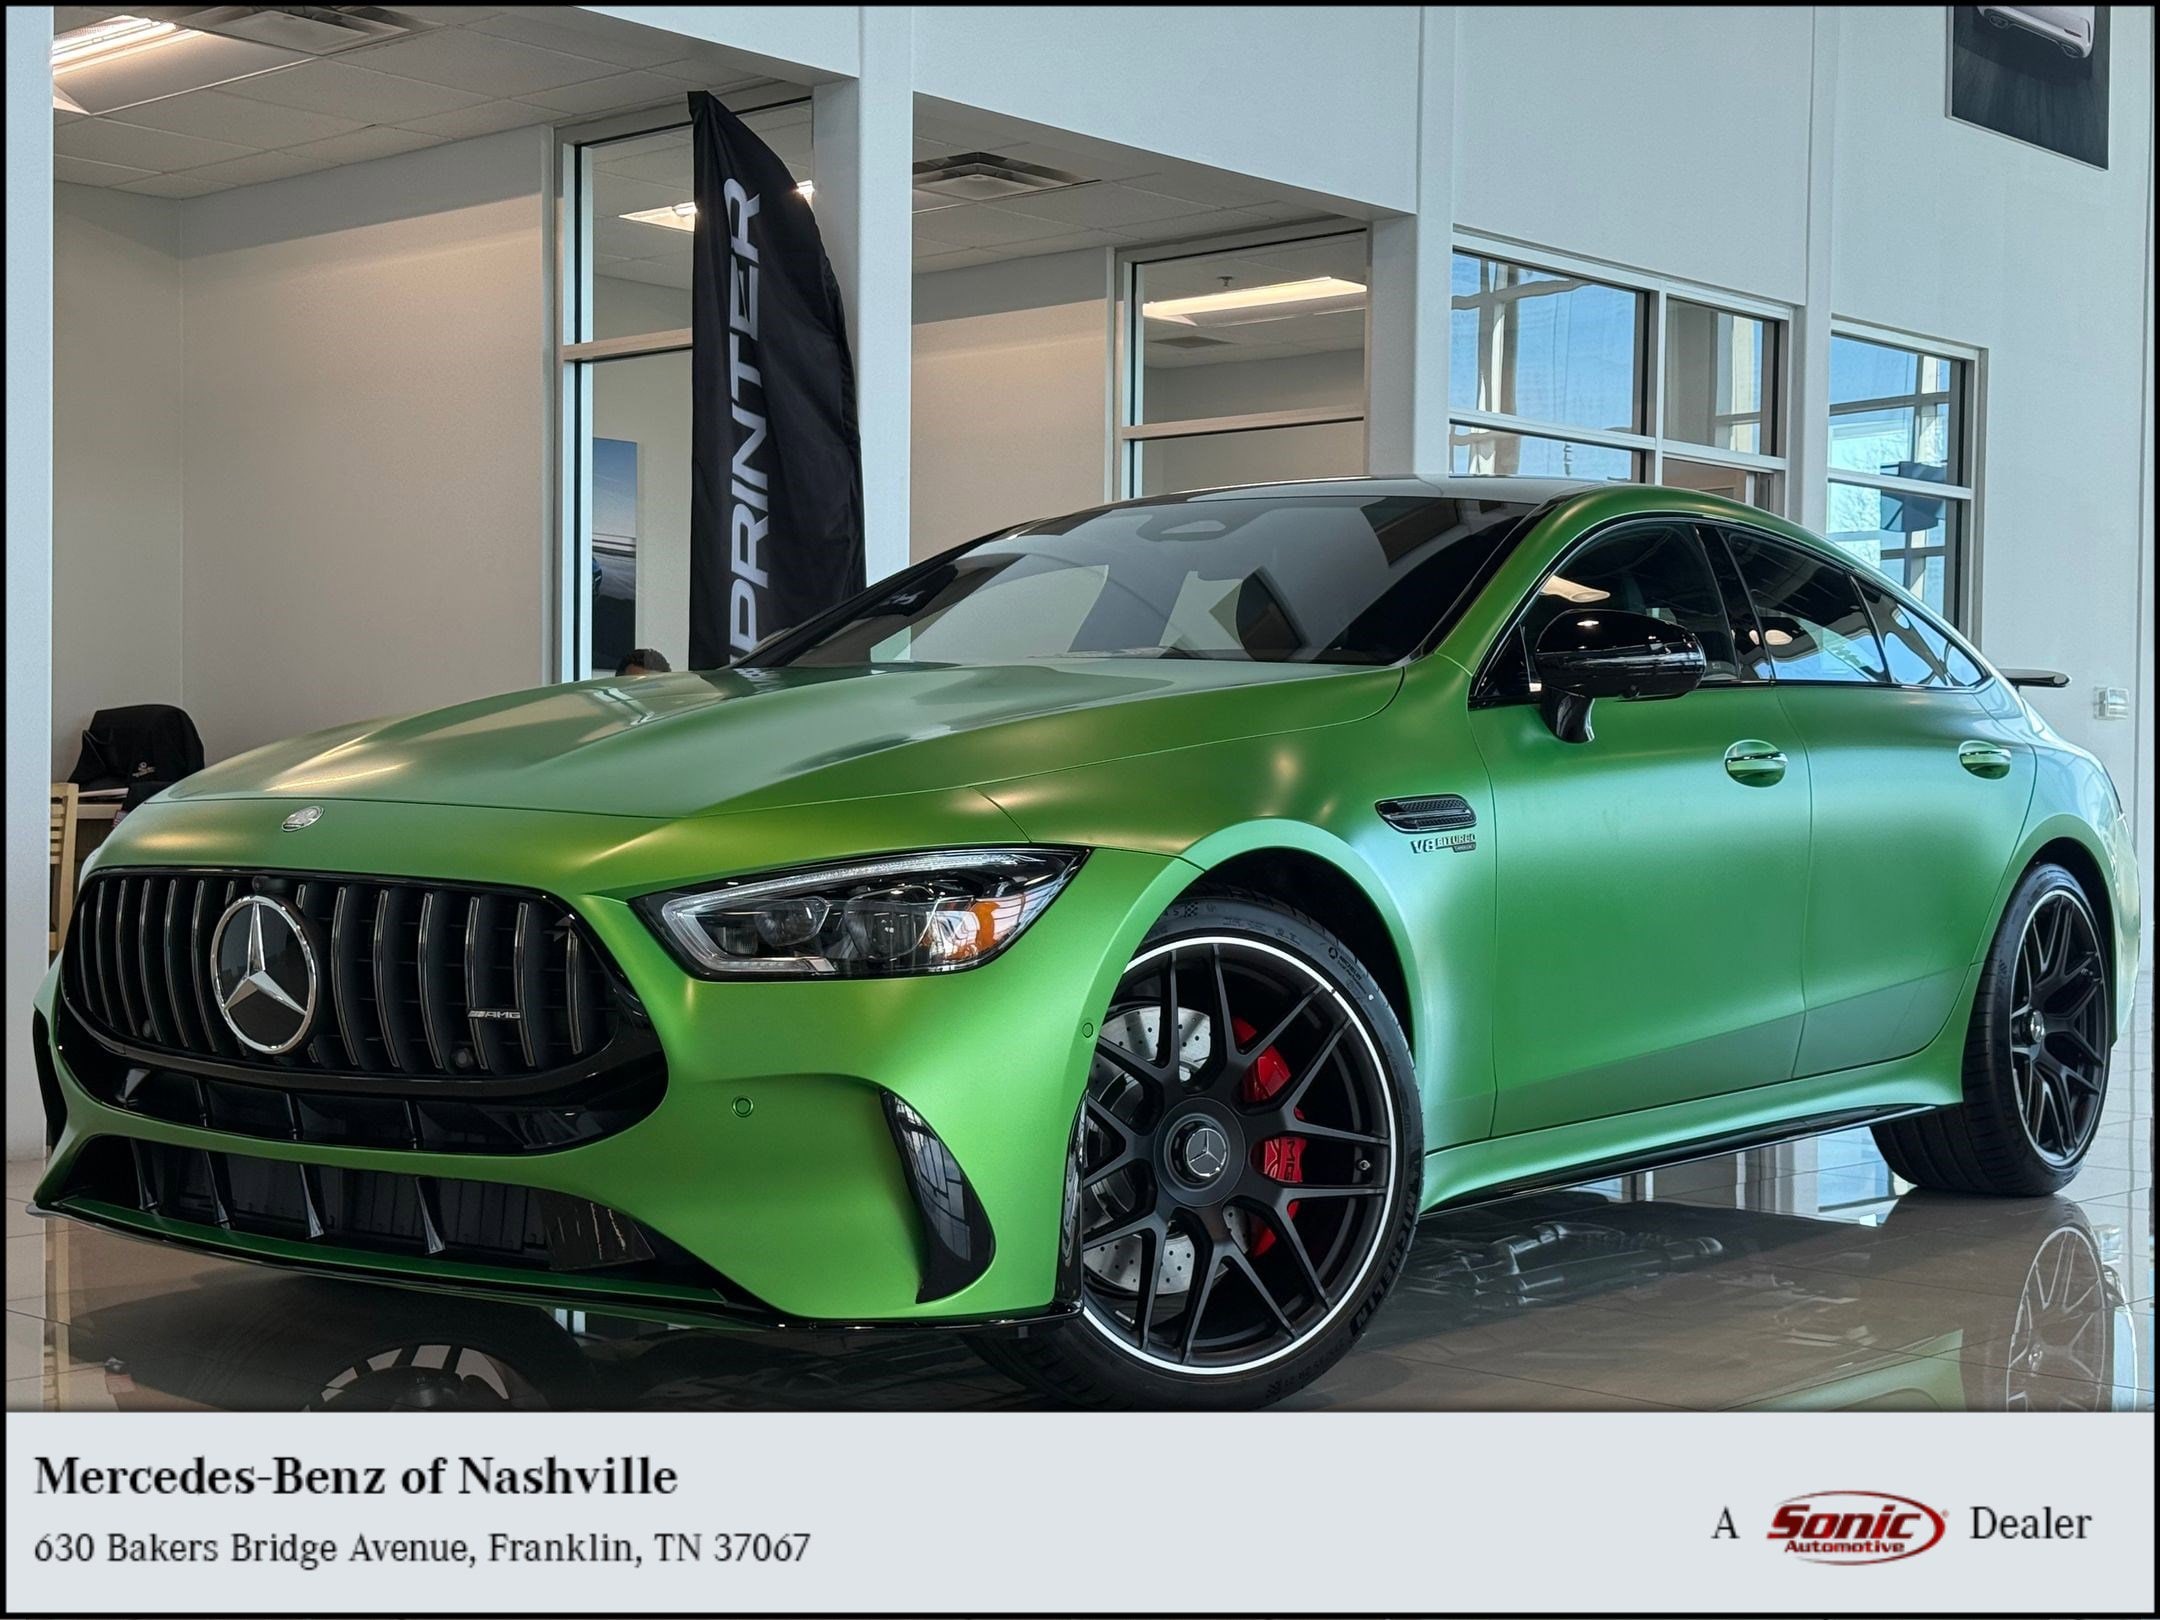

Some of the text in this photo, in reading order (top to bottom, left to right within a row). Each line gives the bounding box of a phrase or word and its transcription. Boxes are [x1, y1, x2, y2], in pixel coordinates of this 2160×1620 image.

[723, 177, 769, 665] PRINTER
[1410, 840, 1435, 854] V8
[483, 1010, 521, 1019] AMG
